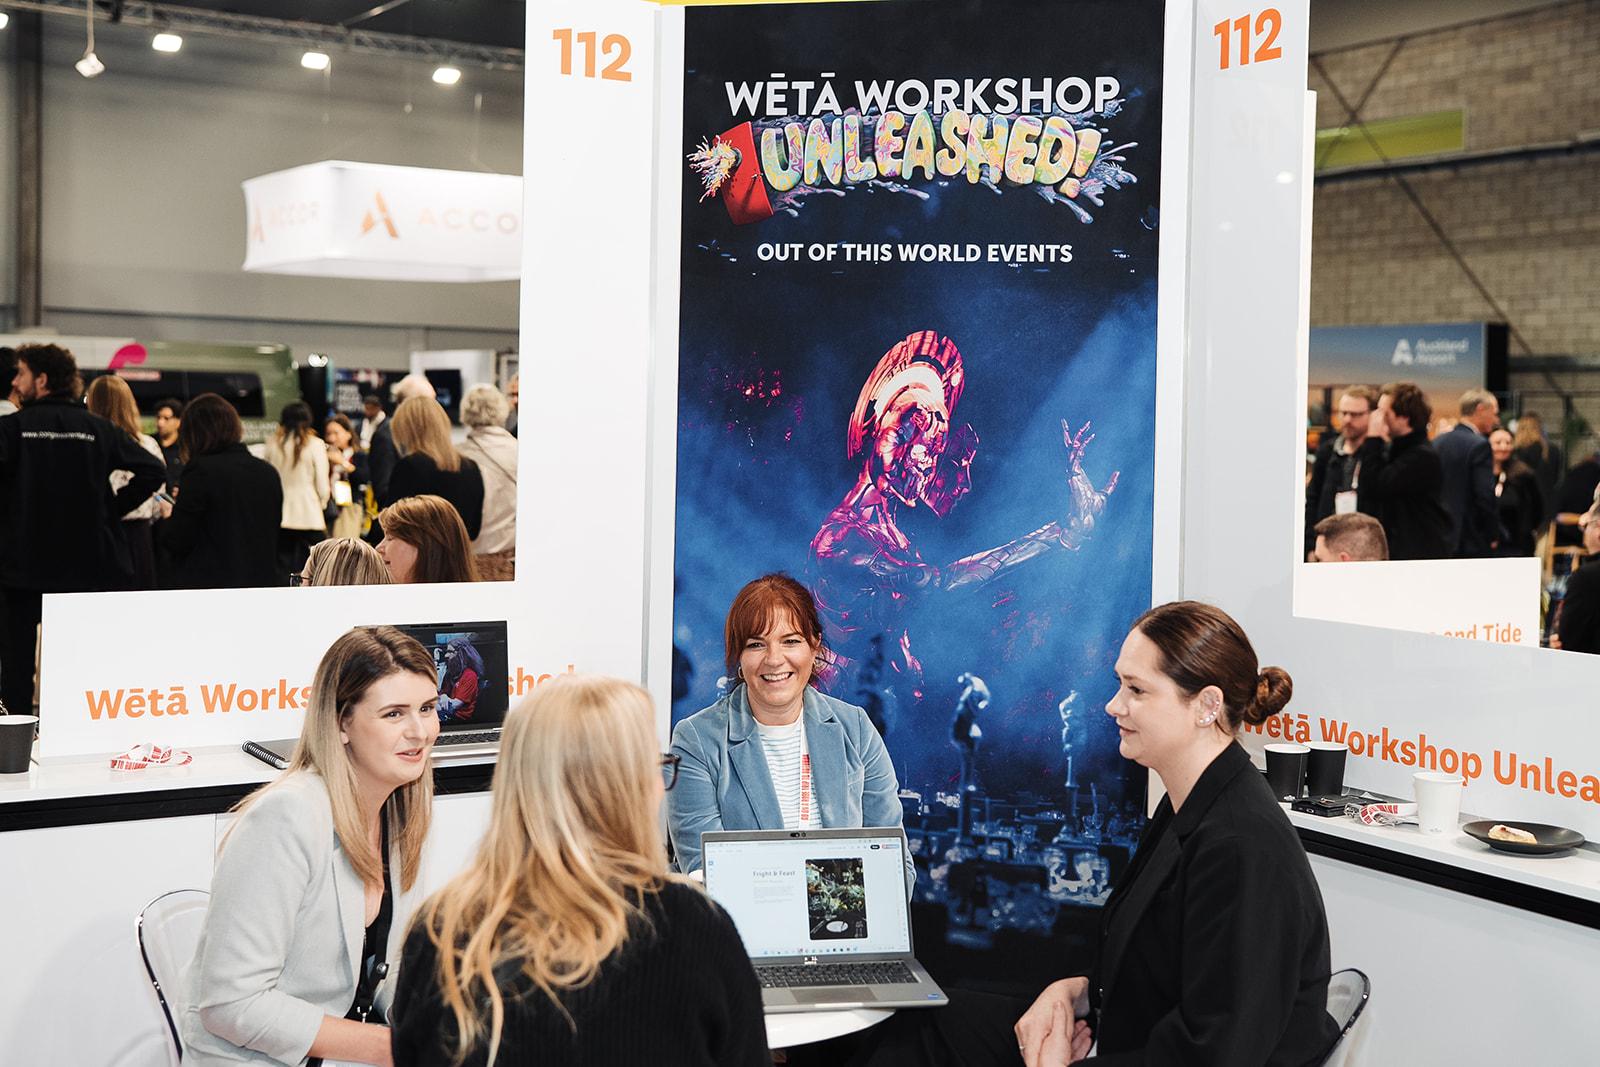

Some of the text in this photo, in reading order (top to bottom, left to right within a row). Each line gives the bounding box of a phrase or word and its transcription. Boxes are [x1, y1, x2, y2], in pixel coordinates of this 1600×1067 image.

[553, 28, 631, 82] 112
[1214, 8, 1282, 70] 112
[725, 72, 1121, 117] WĒTĀ WORKSHOP
[761, 109, 1102, 199] UNLEASHED!
[418, 207, 519, 234] ACCO
[757, 243, 1073, 263] OUT OF THIS WORLD EVENTS
[1483, 623, 1522, 643] Tide
[85, 679, 314, 720] Wētā Works
[1319, 717, 1482, 787] Workshop
